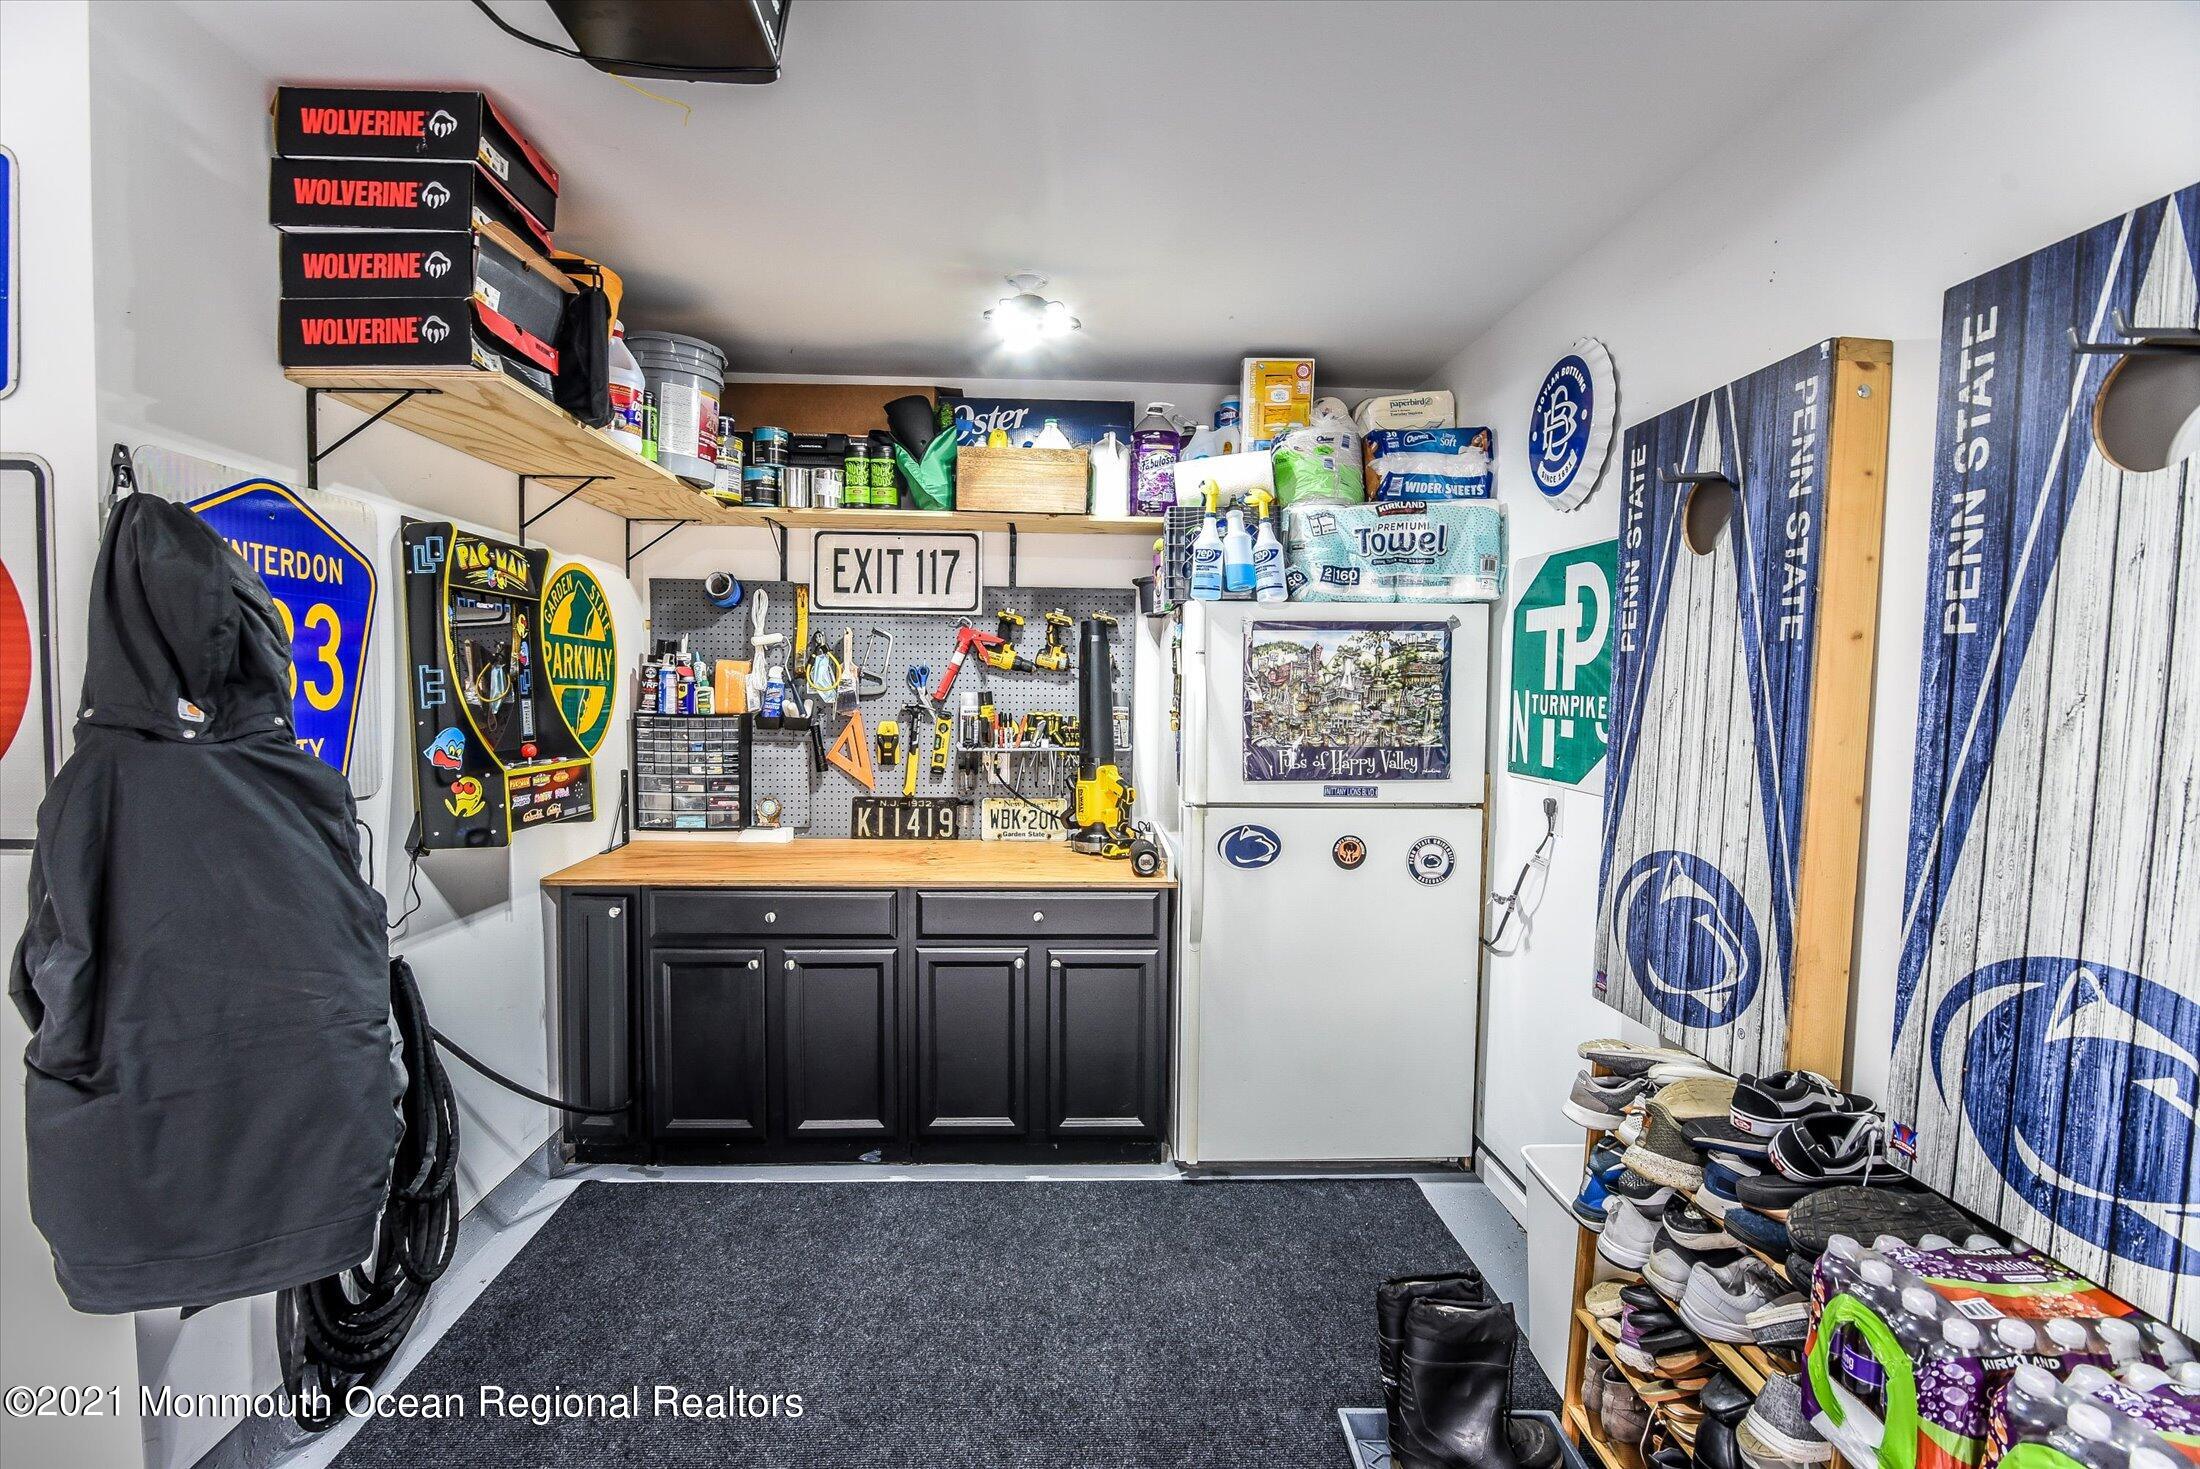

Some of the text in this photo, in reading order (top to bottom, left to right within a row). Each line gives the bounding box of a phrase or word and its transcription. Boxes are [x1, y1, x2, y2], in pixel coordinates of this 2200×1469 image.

[301, 108, 426, 137] WOLVERINE
[293, 178, 418, 208] WOLVERINE
[302, 252, 421, 279] WOLVERINE
[301, 316, 419, 345] WOLVERINE
[1390, 397, 1425, 408] paperbird
[1537, 366, 1586, 413] BOYLAN BOTTLING
[953, 404, 1029, 441] Oster
[1440, 438, 1457, 447] Soft
[1141, 456, 1174, 471] Fabuloso
[1541, 470, 1557, 484] SINCE
[1944, 306, 1998, 635] PENN STATE
[1405, 481, 1484, 496] WIDER SHEETS
[1378, 501, 1426, 512] KIRKLAND
[1779, 374, 1818, 641] PENN STATE
[1354, 525, 1447, 554] Towel
[1620, 442, 1647, 652] PENN STATE
[223, 537, 344, 586] NTERDON
[456, 542, 528, 584] PAC-MAN
[833, 548, 960, 594] EXIT 117
[1336, 570, 1358, 582] 160
[544, 574, 611, 635] GARDEN STATE
[545, 641, 613, 681] PARKWAY
[1532, 694, 1607, 720] TURNPIKE
[1511, 690, 1530, 764] N
[1279, 750, 1417, 775] Pubs of Happy Valley
[858, 807, 953, 837] K11419
[1982, 1356, 2061, 1370] KIRKLAND
